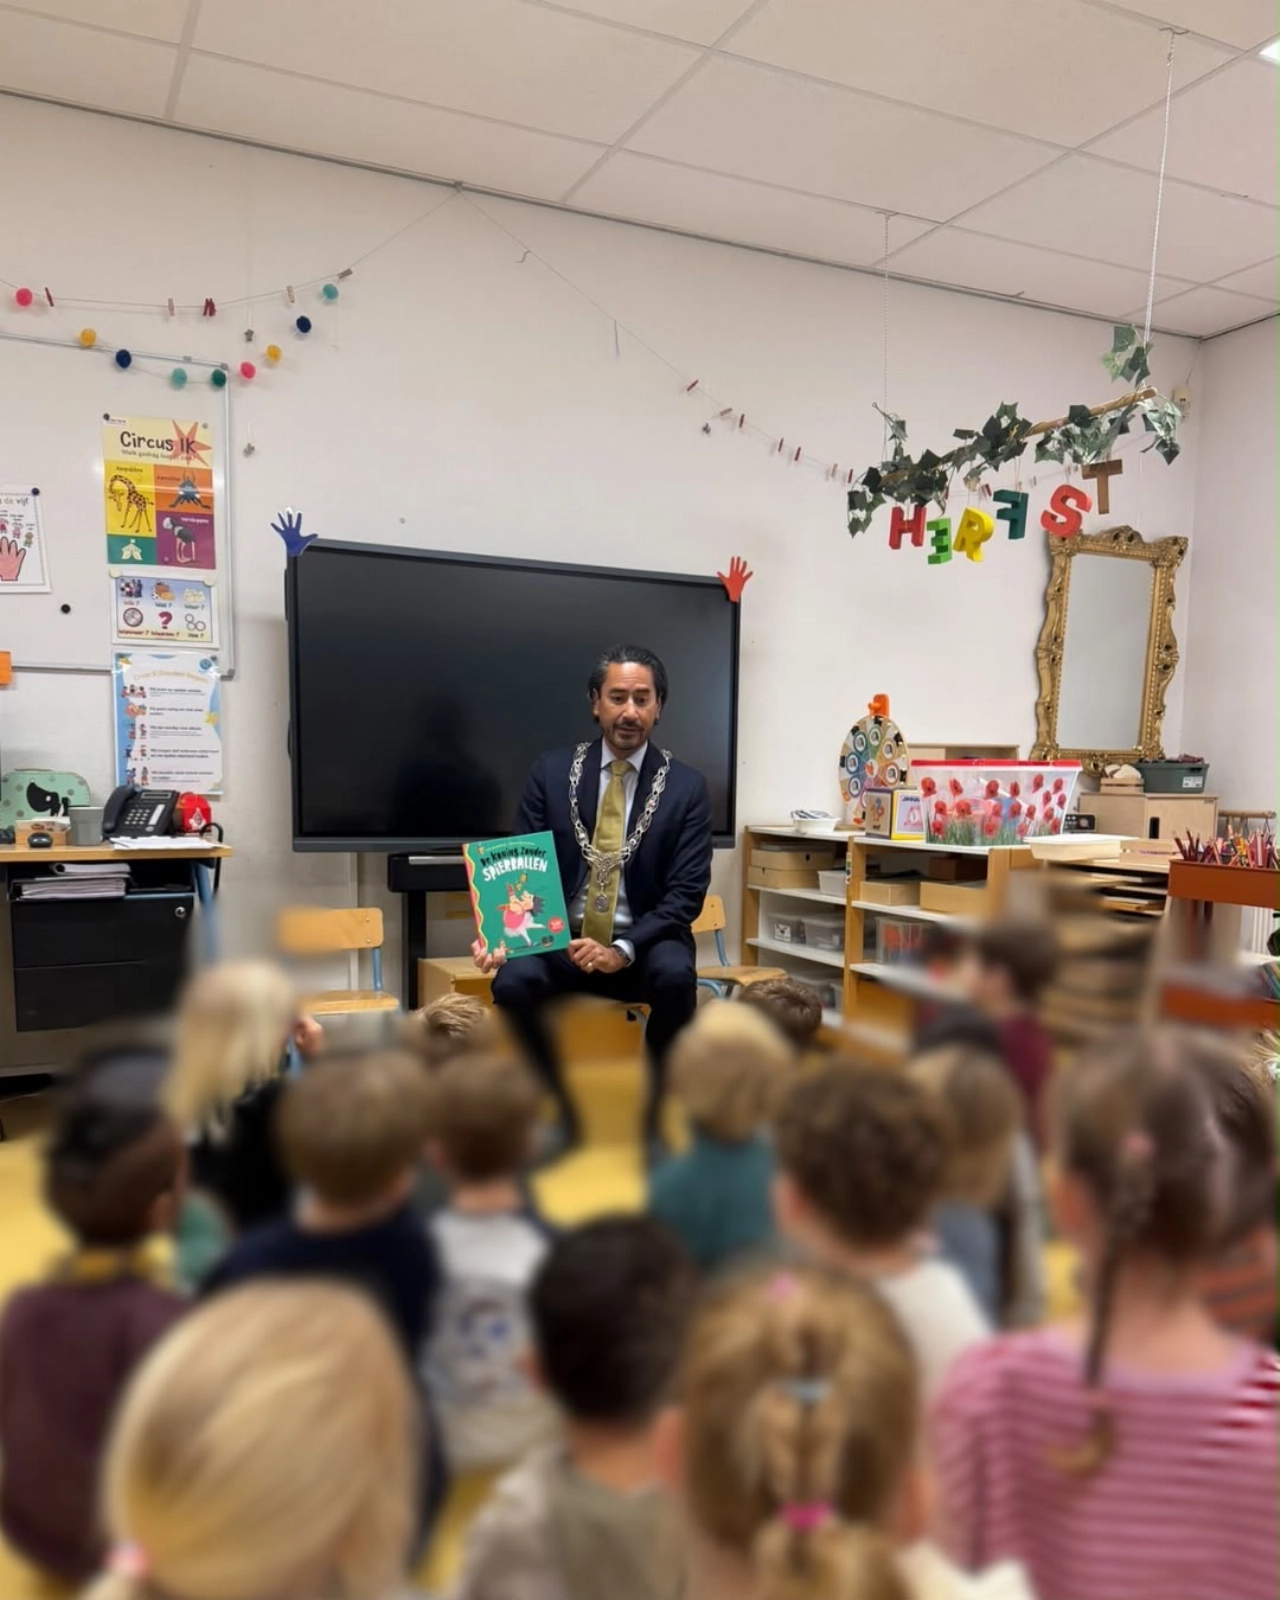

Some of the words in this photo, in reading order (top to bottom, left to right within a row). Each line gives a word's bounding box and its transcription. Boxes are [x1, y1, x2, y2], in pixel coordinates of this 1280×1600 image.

[120, 431, 174, 452] Circus
[180, 437, 197, 454] Ik
[888, 458, 1124, 566] HERFST
[482, 856, 548, 882] SPIERBALLEN
